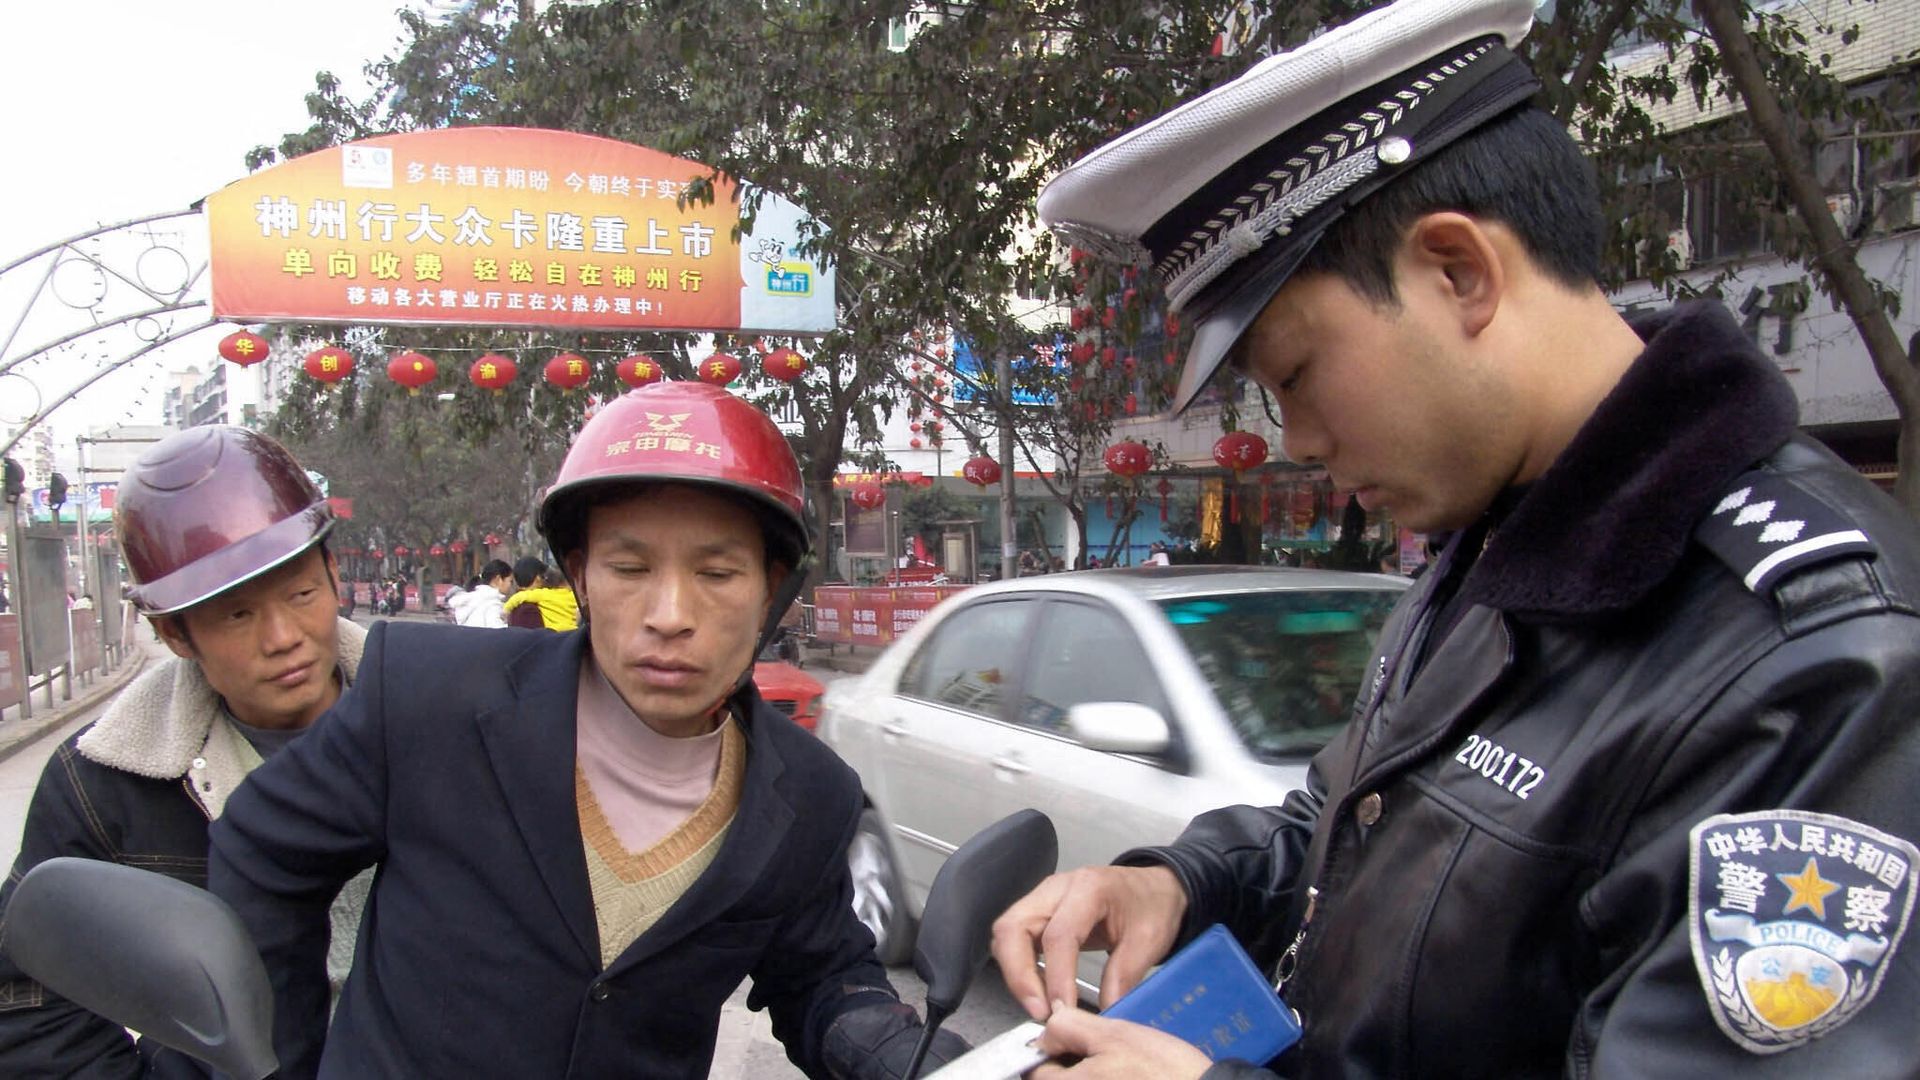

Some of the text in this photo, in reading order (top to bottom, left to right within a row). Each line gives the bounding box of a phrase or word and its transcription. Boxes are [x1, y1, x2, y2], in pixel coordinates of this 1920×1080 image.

[255, 196, 715, 259] 神州行大众卡隆重上市
[283, 248, 703, 292] 单向收费 轻松自在神州行
[236, 338, 254, 355] 华
[320, 355, 338, 371] 创
[566, 360, 583, 376] 西
[634, 362, 651, 378] 新
[710, 362, 726, 378] 天
[786, 354, 801, 369] 地
[606, 437, 721, 459] 宗申摩托
[1455, 734, 1545, 800] 200172
[1705, 823, 1908, 889] 中华人民共和国
[1717, 861, 1891, 934] 警 察
[1760, 924, 1842, 955] POLICE
[1762, 957, 1781, 977] 公
